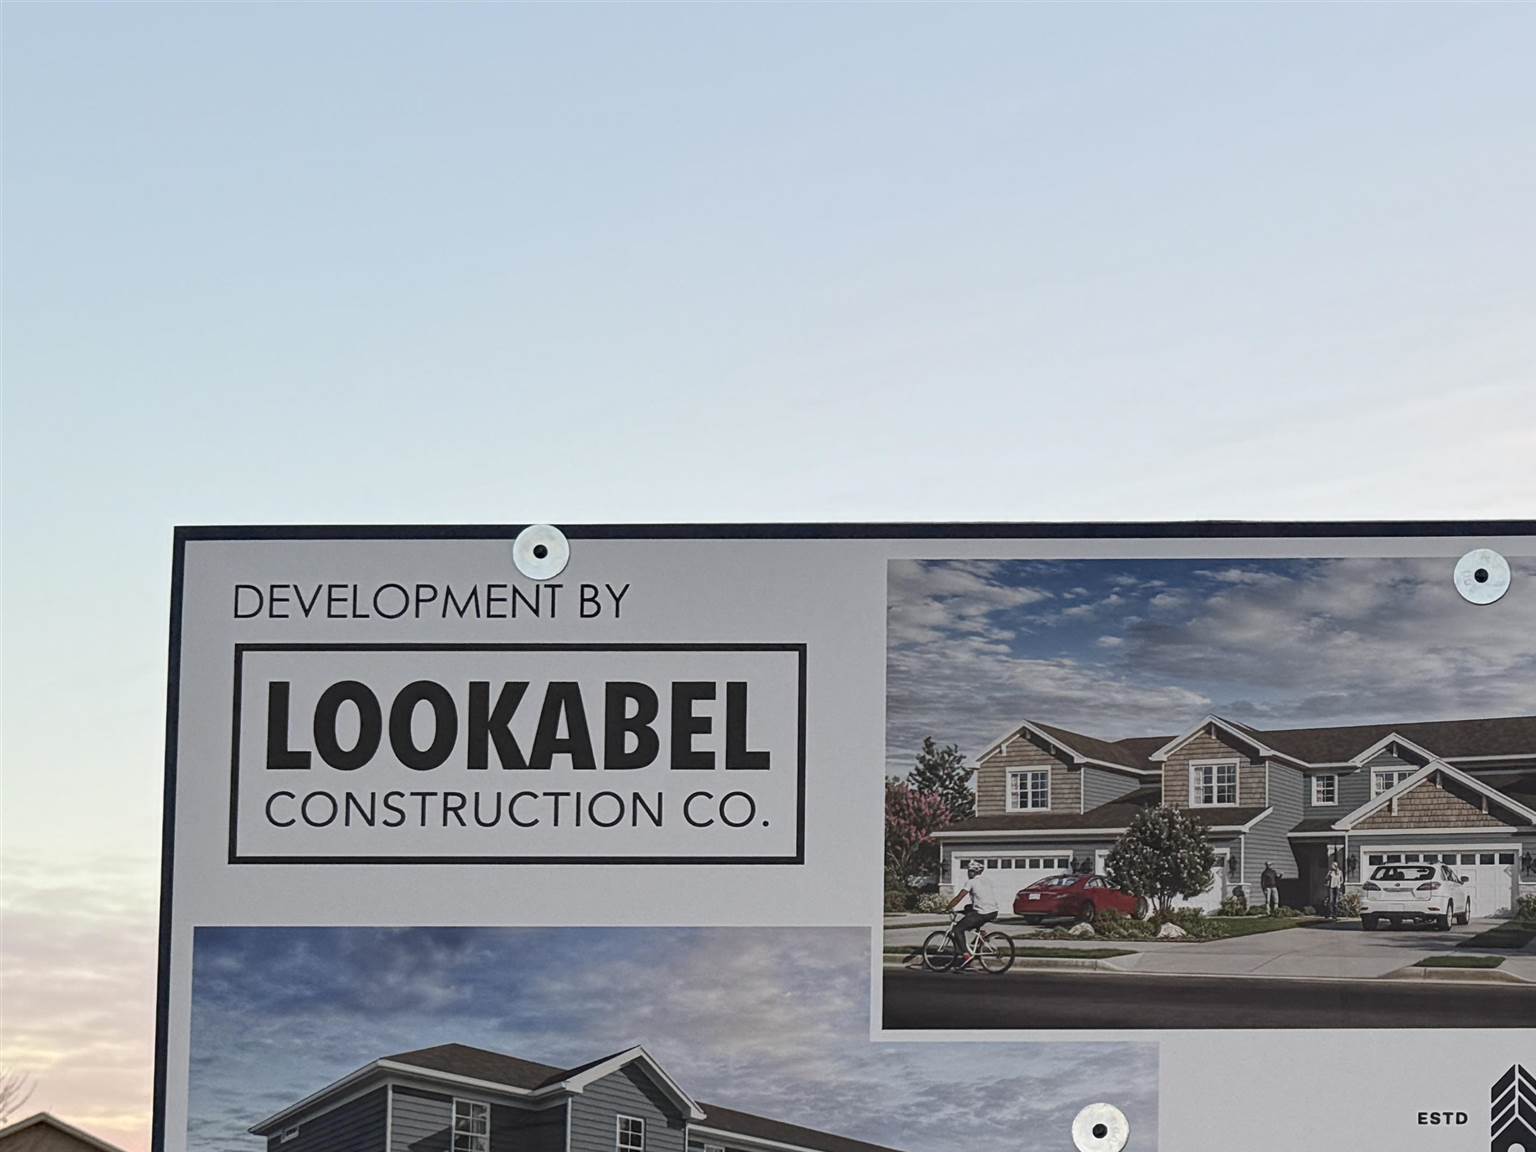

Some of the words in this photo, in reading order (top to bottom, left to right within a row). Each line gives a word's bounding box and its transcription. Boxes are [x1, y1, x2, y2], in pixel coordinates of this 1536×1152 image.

[234, 583, 565, 620] DEVELOPMENT
[580, 583, 631, 619] BY
[266, 679, 771, 772] LOOKABEL
[265, 790, 666, 829] CONSTRUCTION
[683, 790, 770, 828] CO.
[1417, 1111, 1468, 1125] ESTD
